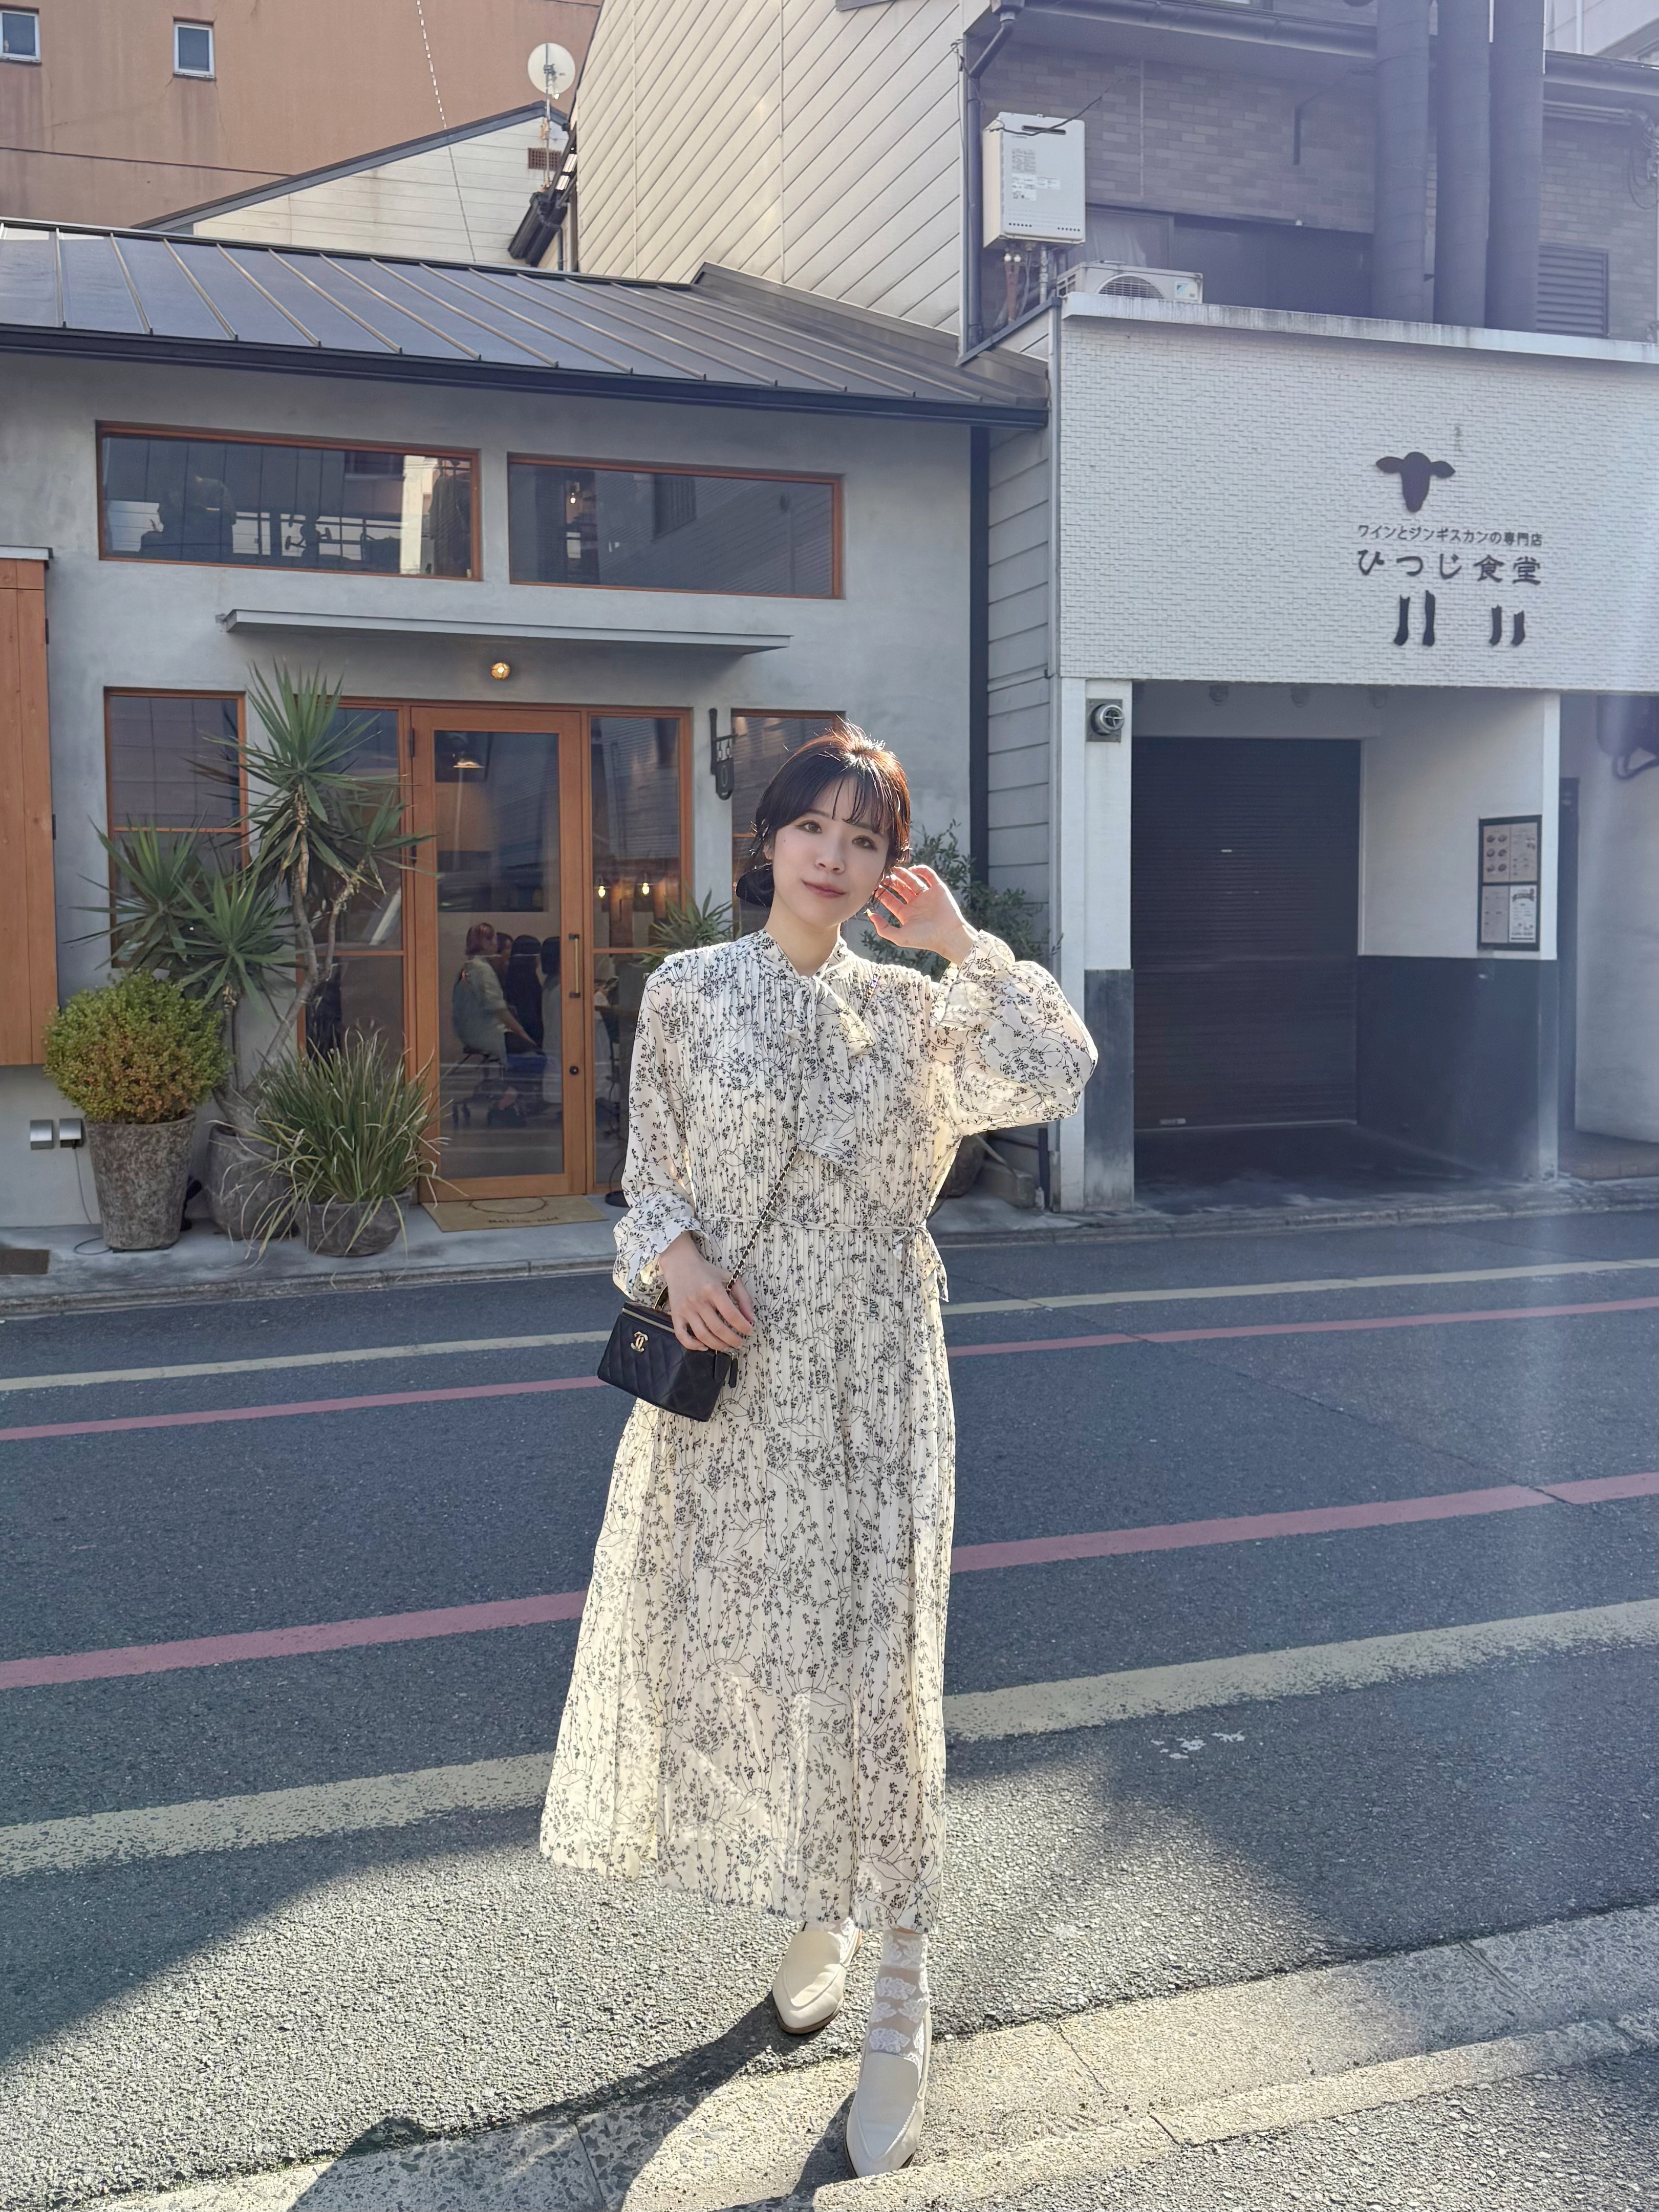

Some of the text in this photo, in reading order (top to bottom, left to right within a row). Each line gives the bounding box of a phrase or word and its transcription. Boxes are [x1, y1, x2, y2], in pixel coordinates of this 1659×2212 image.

[1359, 525, 1542, 546] ワインとジンギスカンの専門店
[1358, 550, 1541, 585] ひつじ食堂
